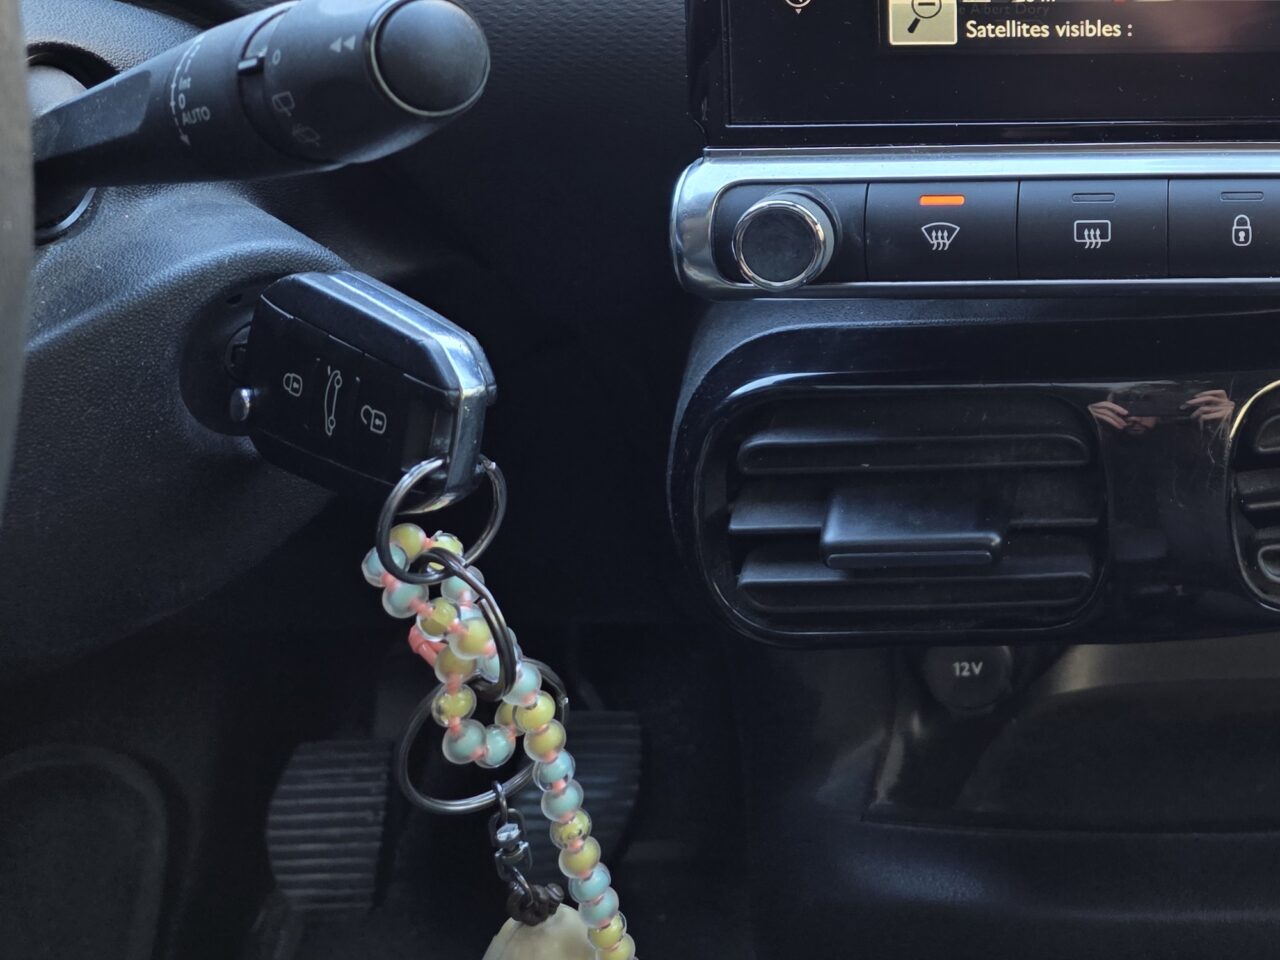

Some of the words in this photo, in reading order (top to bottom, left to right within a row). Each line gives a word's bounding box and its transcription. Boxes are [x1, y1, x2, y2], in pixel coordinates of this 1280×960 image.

[966, 20, 1050, 38] Satellites
[1055, 19, 1122, 38] visibles
[178, 94, 186, 109] 0
[182, 106, 211, 125] AUTO
[953, 661, 983, 676] 12V
